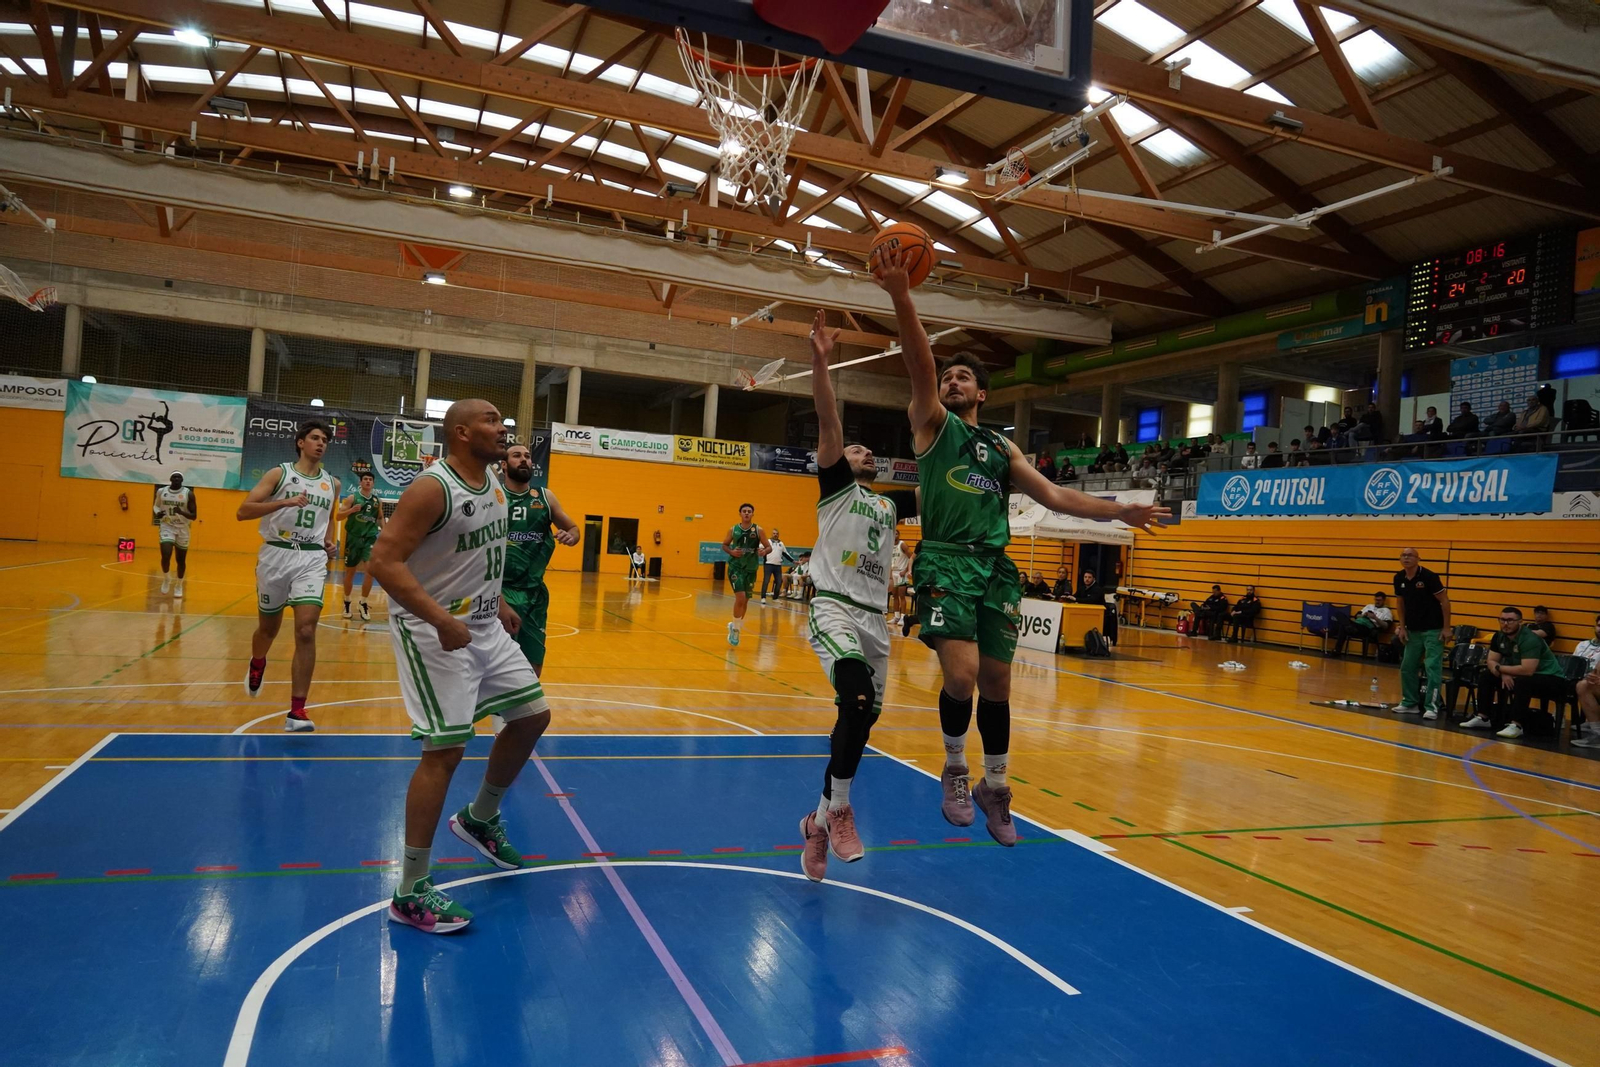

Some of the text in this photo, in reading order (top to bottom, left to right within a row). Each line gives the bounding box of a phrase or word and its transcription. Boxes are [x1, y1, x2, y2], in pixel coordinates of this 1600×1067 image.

[1466, 243, 1505, 265] 08:16
[1444, 257, 1526, 281] LOCAL VISITANTE
[1366, 285, 1394, 295] PROGRAMA
[1448, 268, 1526, 298] 24 2 20
[1514, 288, 1530, 297] FALTA
[1436, 323, 1453, 331] FALTAS
[1483, 315, 1501, 323] FALTAS
[1442, 331, 1451, 343] 2
[77, 420, 160, 461] Poniente
[184, 434, 201, 442] 603
[565, 429, 592, 440] mce
[611, 438, 669, 451] CAMPOEJIDO
[697, 439, 741, 456] NOCTUA
[975, 441, 989, 462] 6
[384, 489, 396, 497] que
[1270, 477, 1326, 506] FUTSAL
[1377, 481, 1391, 489] RF
[1431, 469, 1509, 503] FUTSAL
[285, 491, 331, 511] ANUJAR
[366, 504, 372, 512] 2
[295, 508, 316, 529] 19
[512, 506, 527, 521] 21
[119, 541, 134, 550] 20
[867, 526, 880, 552] 5
[484, 546, 502, 581] 18
[857, 554, 884, 577] Jaén
